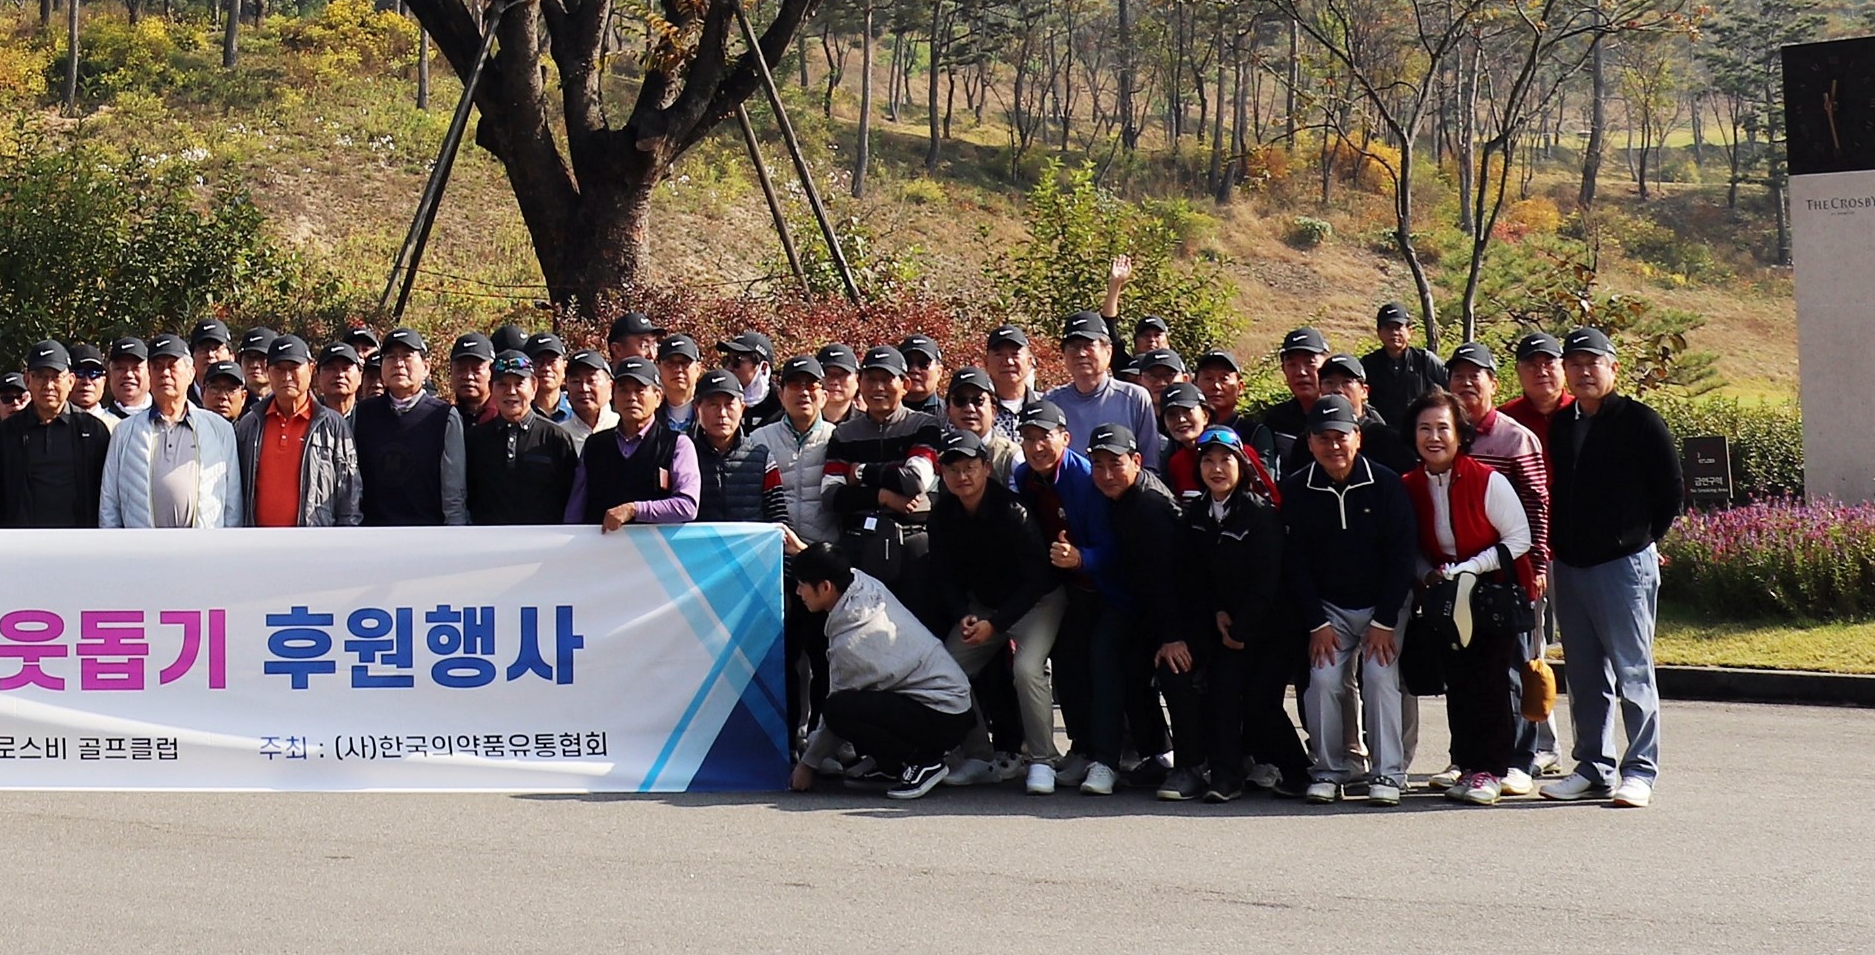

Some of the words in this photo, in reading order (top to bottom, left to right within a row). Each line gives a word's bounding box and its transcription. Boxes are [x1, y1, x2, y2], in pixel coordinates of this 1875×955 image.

[1806, 199, 1829, 210] THE
[1694, 476, 1724, 487] 금연구역
[262, 604, 585, 690] 후원행사
[78, 737, 178, 762] 골프클럽
[259, 735, 309, 761] 주최
[334, 730, 609, 761] (사)한국의약품유통협회
